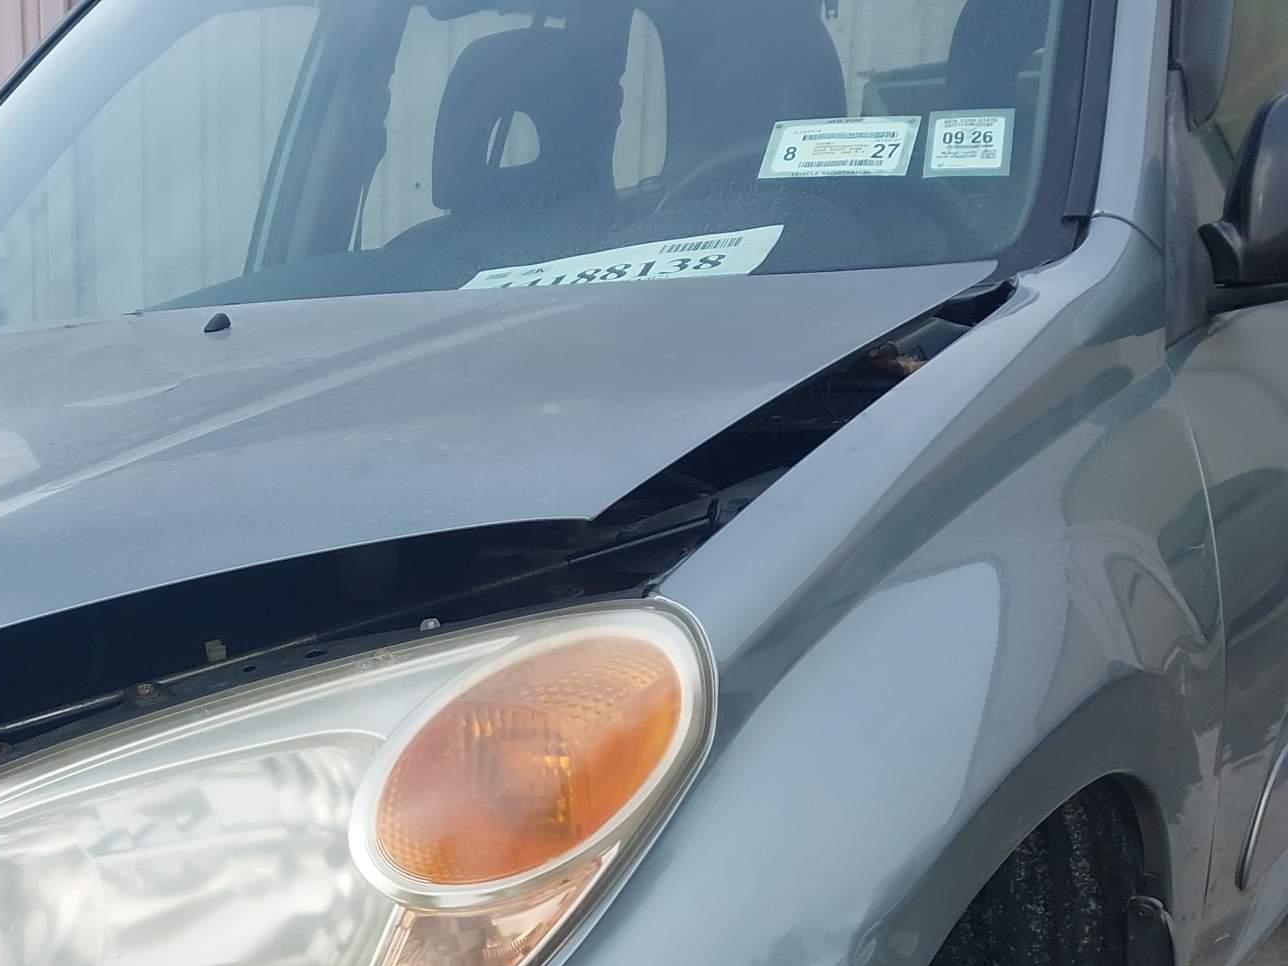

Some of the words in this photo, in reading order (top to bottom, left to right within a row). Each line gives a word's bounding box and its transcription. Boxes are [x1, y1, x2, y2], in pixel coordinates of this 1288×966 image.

[942, 130, 965, 145] 09
[971, 129, 994, 144] 26
[783, 146, 798, 161] 8
[870, 143, 901, 159] 27
